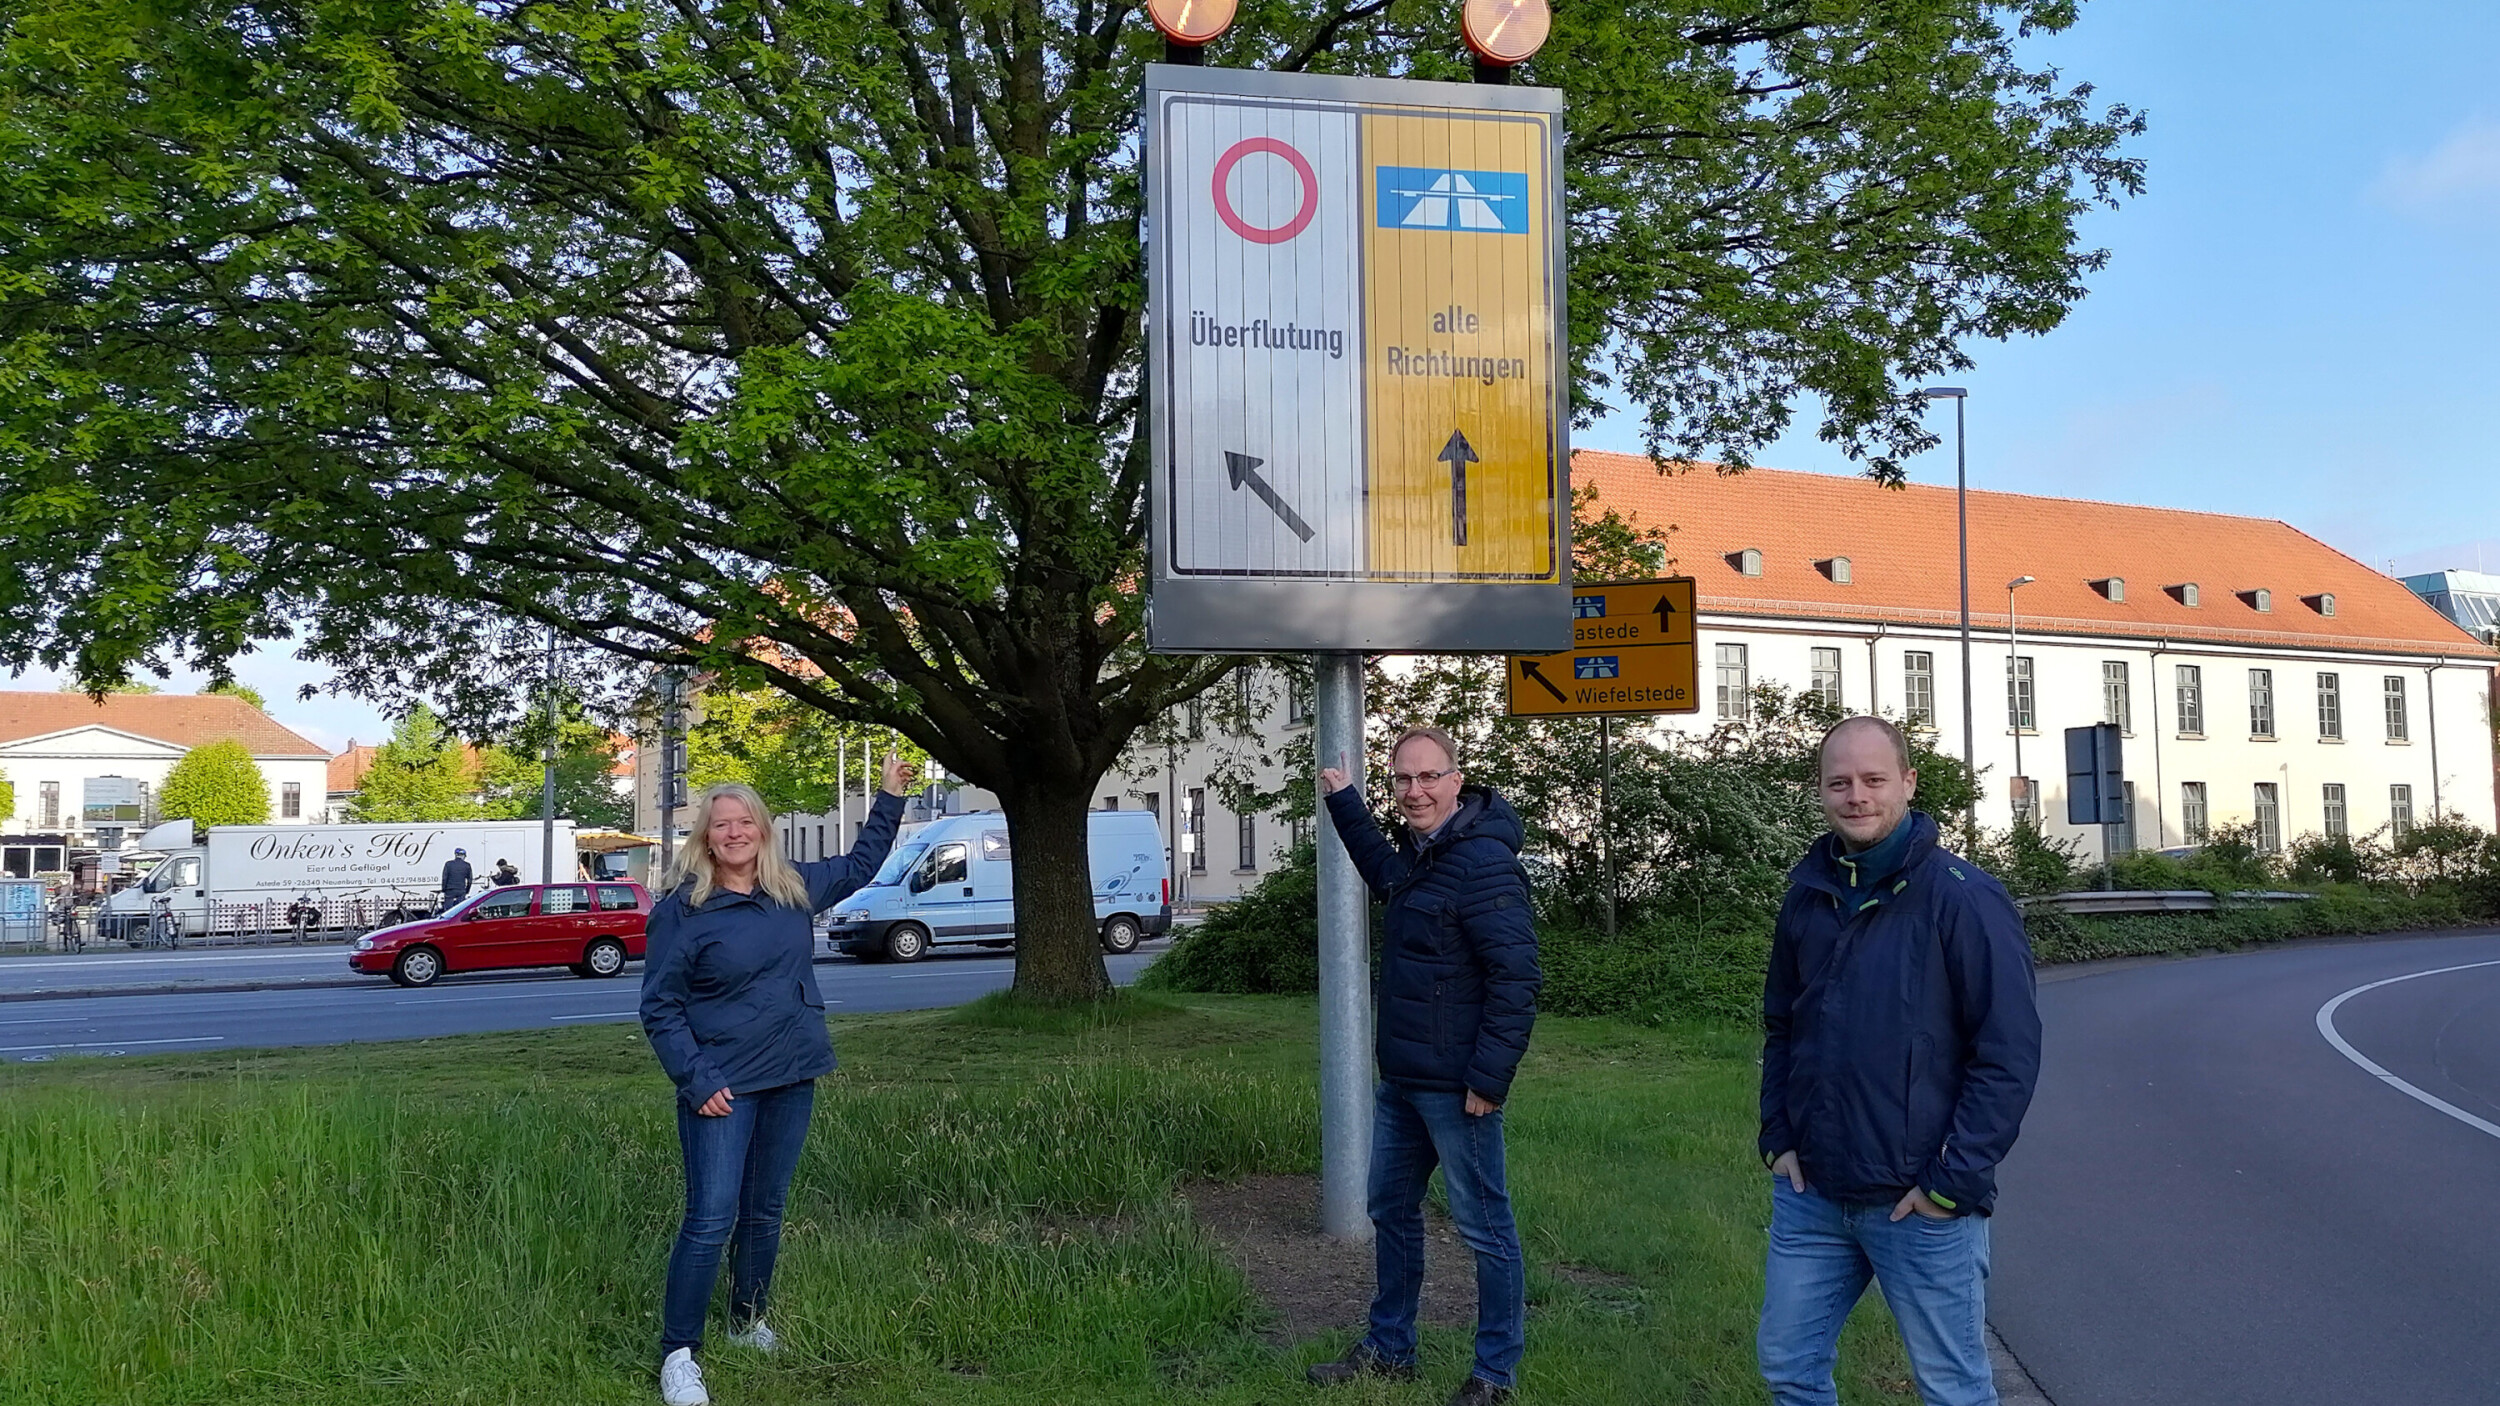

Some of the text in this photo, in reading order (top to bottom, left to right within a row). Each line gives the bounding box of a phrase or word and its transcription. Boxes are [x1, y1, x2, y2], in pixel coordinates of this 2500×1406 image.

[1433, 305, 1480, 334] alle
[1191, 310, 1343, 360] Überflutung
[1387, 346, 1525, 386] Richtungen
[1575, 622, 1639, 641] astede
[1575, 684, 1685, 704] Wiefelstede
[366, 831, 444, 865] Hof
[306, 863, 390, 873] Eier und Geflügel
[282, 879, 292, 887] 59
